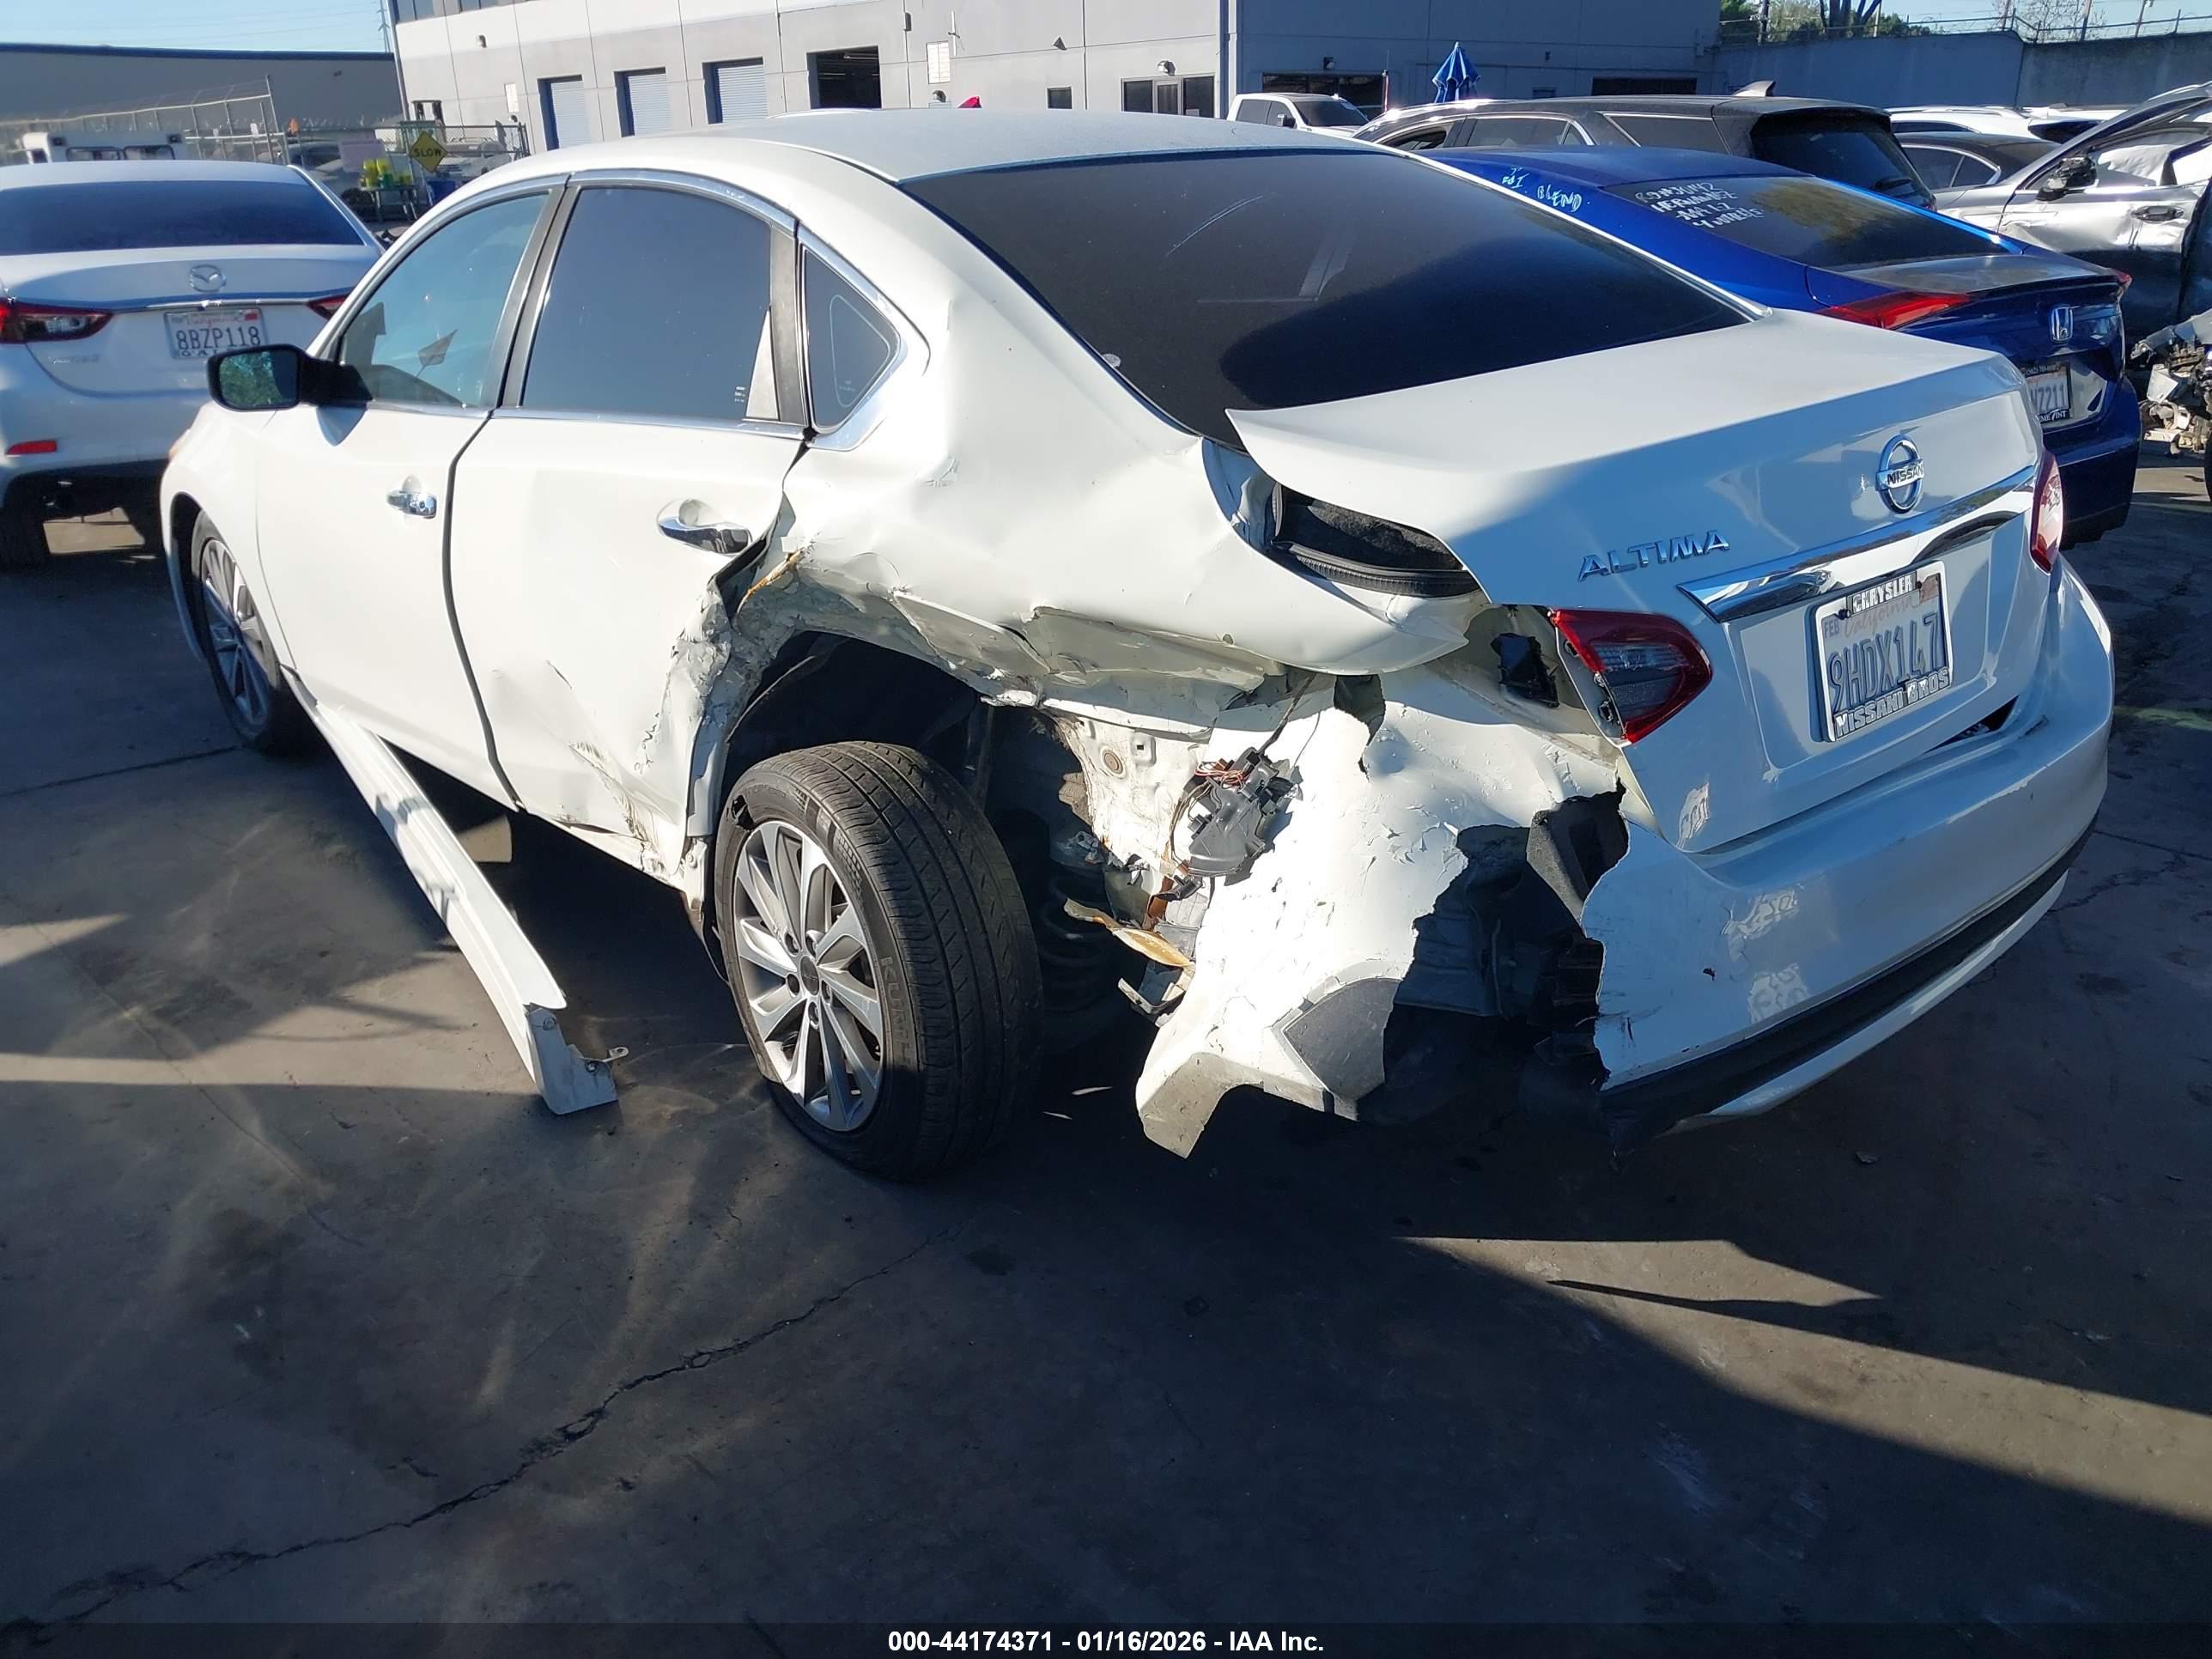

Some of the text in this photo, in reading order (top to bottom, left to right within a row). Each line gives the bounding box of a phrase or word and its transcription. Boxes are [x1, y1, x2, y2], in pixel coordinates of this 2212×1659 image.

[414, 148, 441, 157] SLOW
[176, 325, 261, 349] 8BZP118
[1887, 464, 1924, 485] NISSAN
[1577, 530, 1730, 582] ALTIMA
[1852, 574, 1914, 614] CHRYSLER
[1824, 619, 1840, 639] FEB
[1828, 611, 1939, 712] 9HDX147
[1834, 667, 1951, 738] NISSANI BROS
